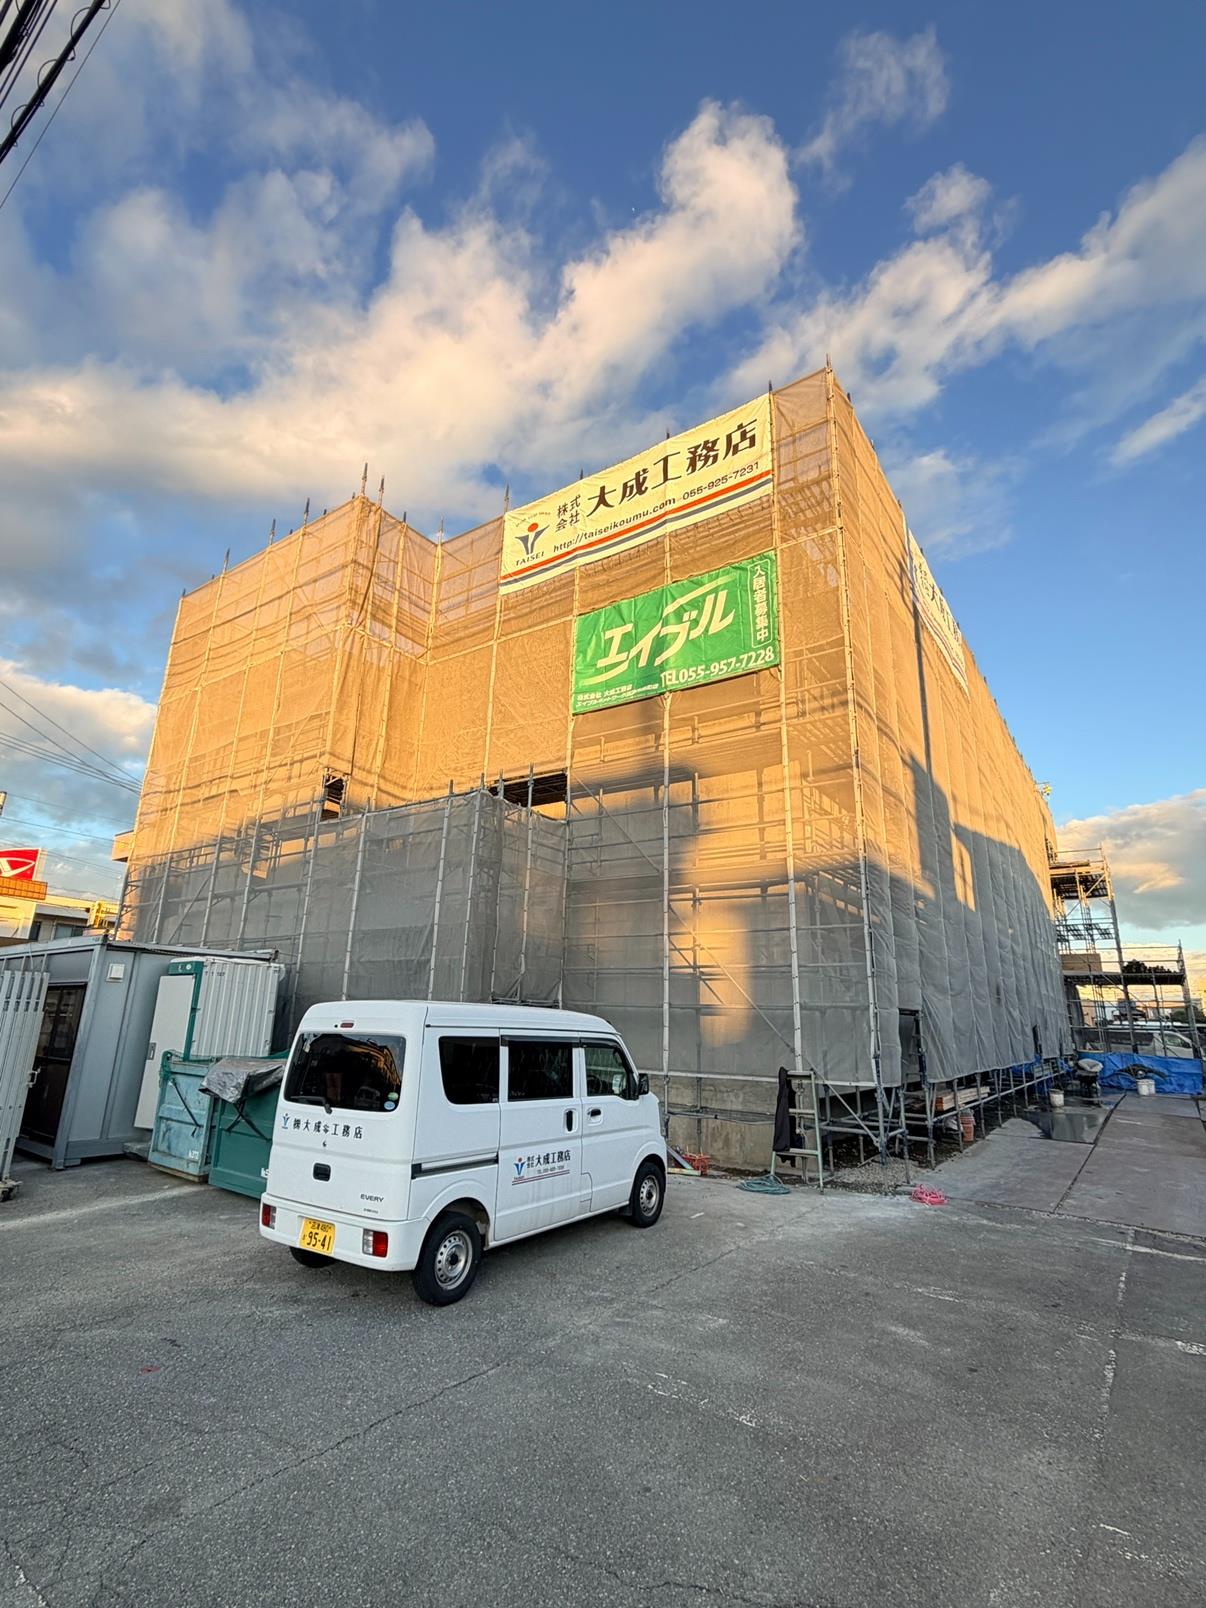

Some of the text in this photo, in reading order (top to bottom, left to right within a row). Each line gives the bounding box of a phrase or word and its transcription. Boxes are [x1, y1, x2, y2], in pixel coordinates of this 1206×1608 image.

[553, 461, 760, 552] http://taiseikoumu.com 055-925-7231
[586, 418, 758, 518] 大成工務店
[515, 551, 545, 566] TAISEI
[583, 577, 738, 684] エイブル
[752, 565, 769, 642] 入居者募集中
[535, 1149, 571, 1168] 大成工務店
[360, 1193, 384, 1202] EVERY
